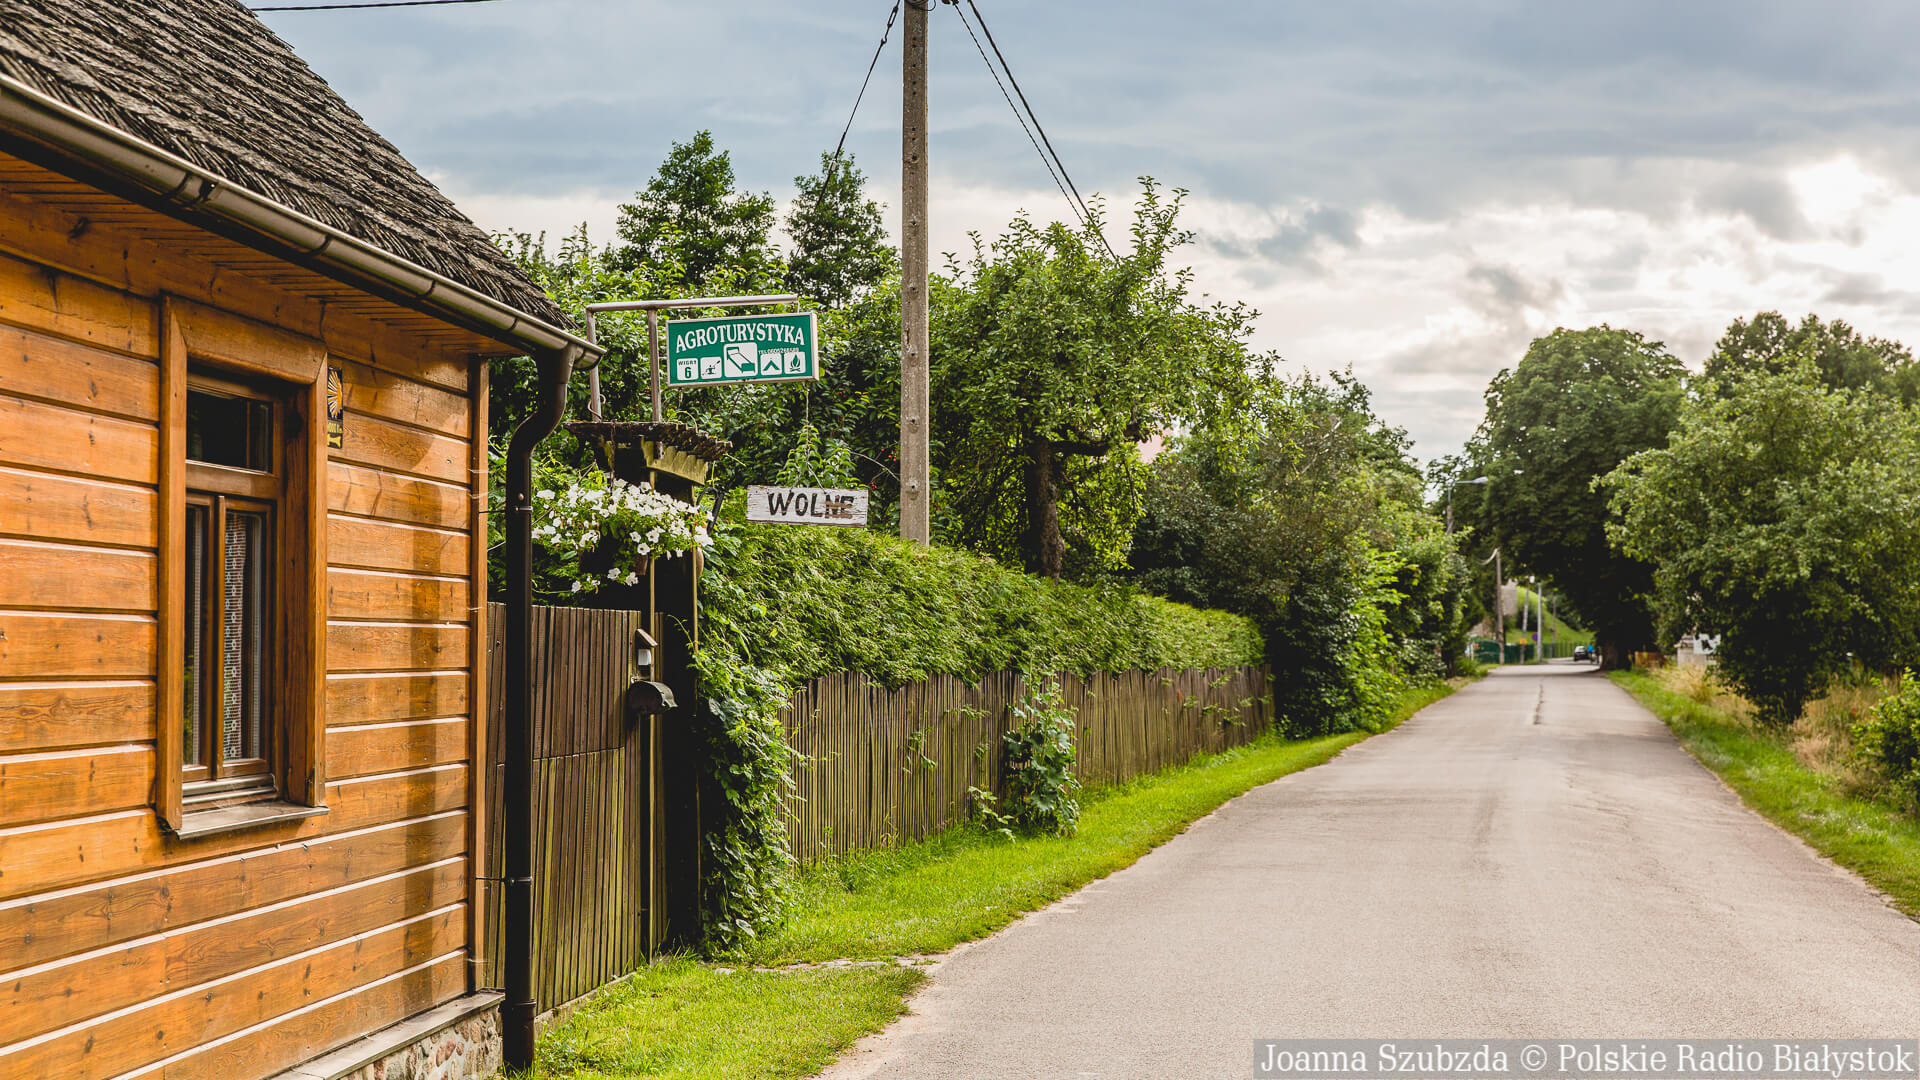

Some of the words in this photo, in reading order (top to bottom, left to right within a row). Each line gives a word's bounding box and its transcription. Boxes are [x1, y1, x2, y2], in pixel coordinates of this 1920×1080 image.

[676, 323, 805, 353] AGROTURYSTYKA
[684, 366, 692, 379] 6
[767, 491, 855, 519] WOLNE
